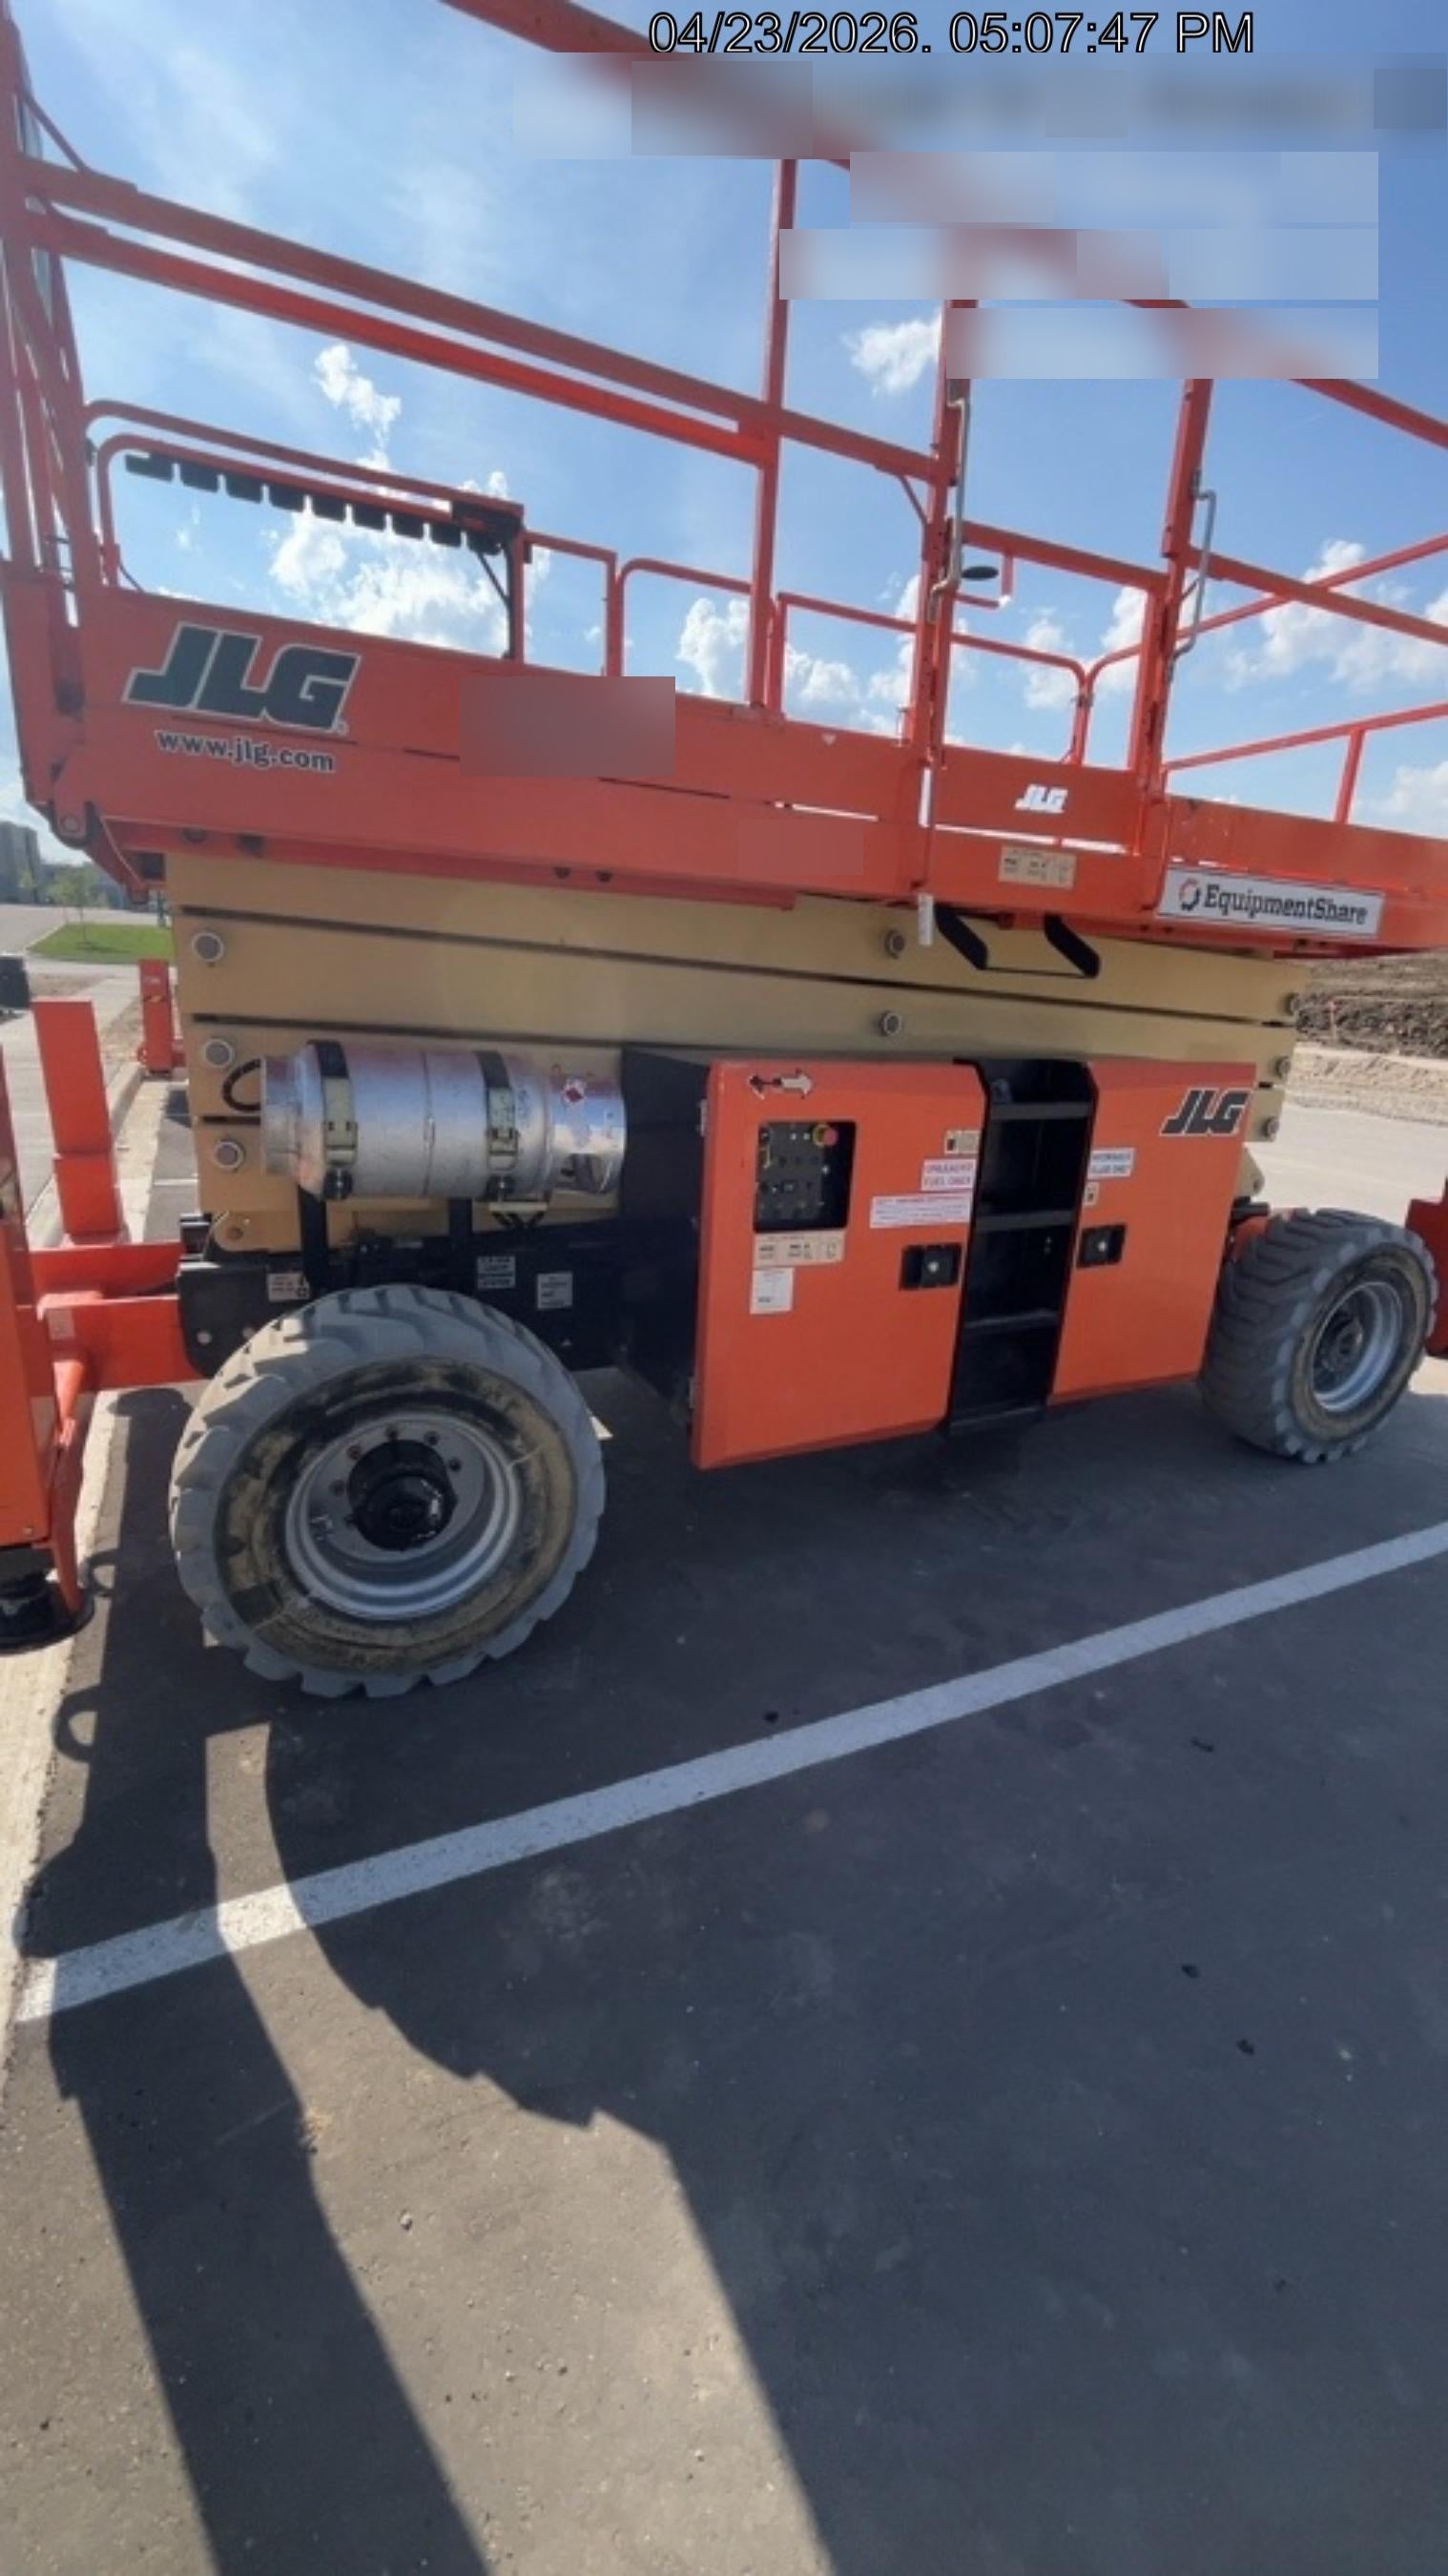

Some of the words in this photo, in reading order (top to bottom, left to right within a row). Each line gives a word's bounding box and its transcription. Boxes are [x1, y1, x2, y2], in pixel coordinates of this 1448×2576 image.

[123, 622, 361, 733] JLG
[155, 730, 336, 773] www.jlg.com
[1014, 783, 1068, 814] JLG
[1204, 883, 1369, 924] EquipmentShare
[1159, 1087, 1253, 1137] JLG
